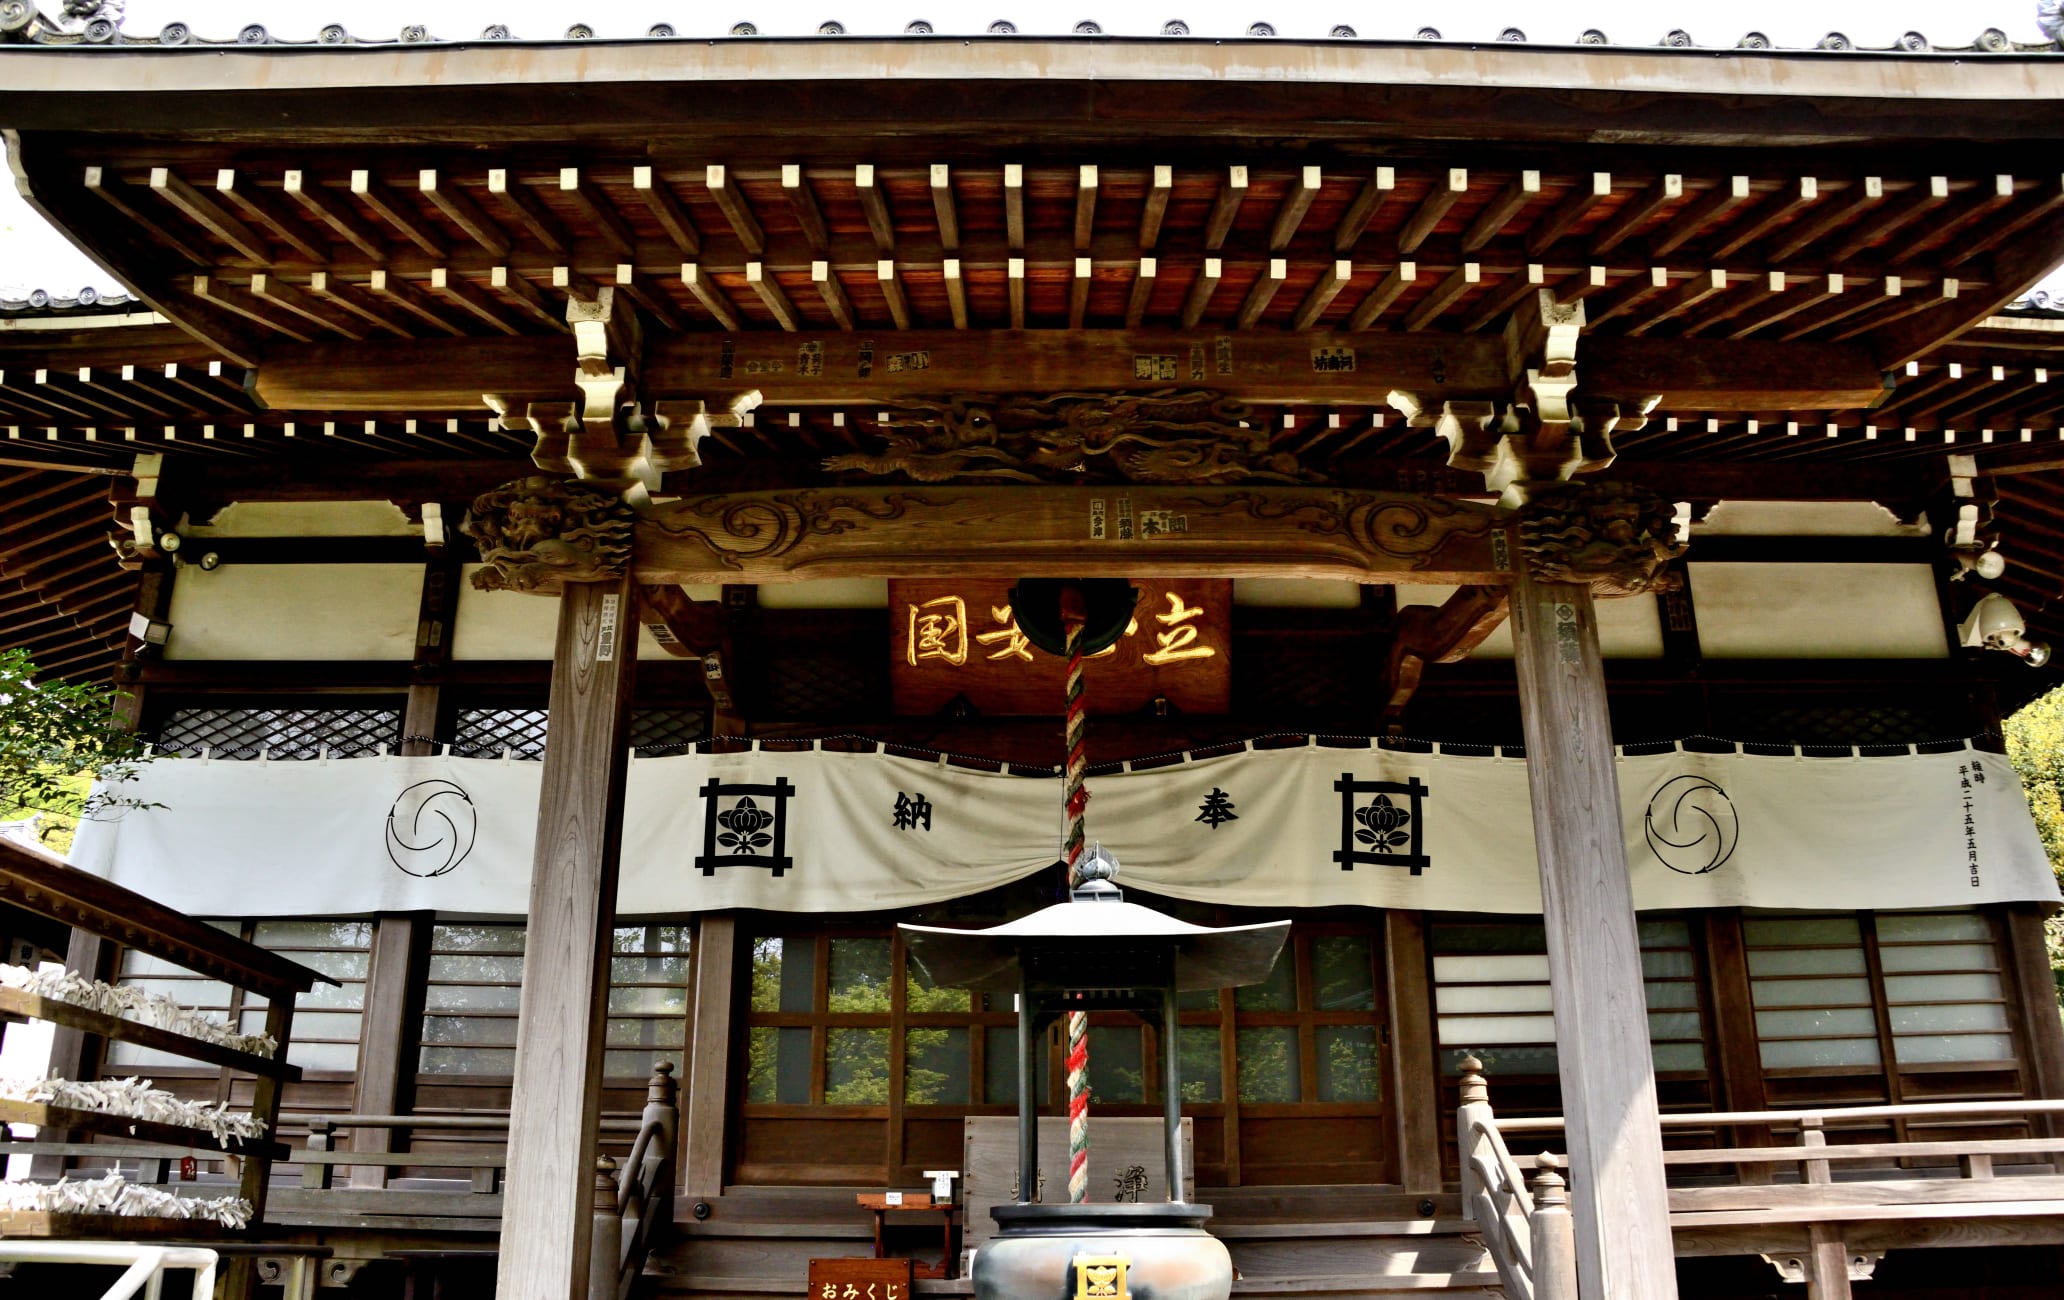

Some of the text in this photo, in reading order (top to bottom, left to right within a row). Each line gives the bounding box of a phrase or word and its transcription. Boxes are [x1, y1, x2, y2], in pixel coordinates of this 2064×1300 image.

[892, 787, 1239, 832] 奉 納
[1958, 765, 1980, 888] 平成二十五年五月吉日
[822, 1282, 898, 1300] おみくじ
